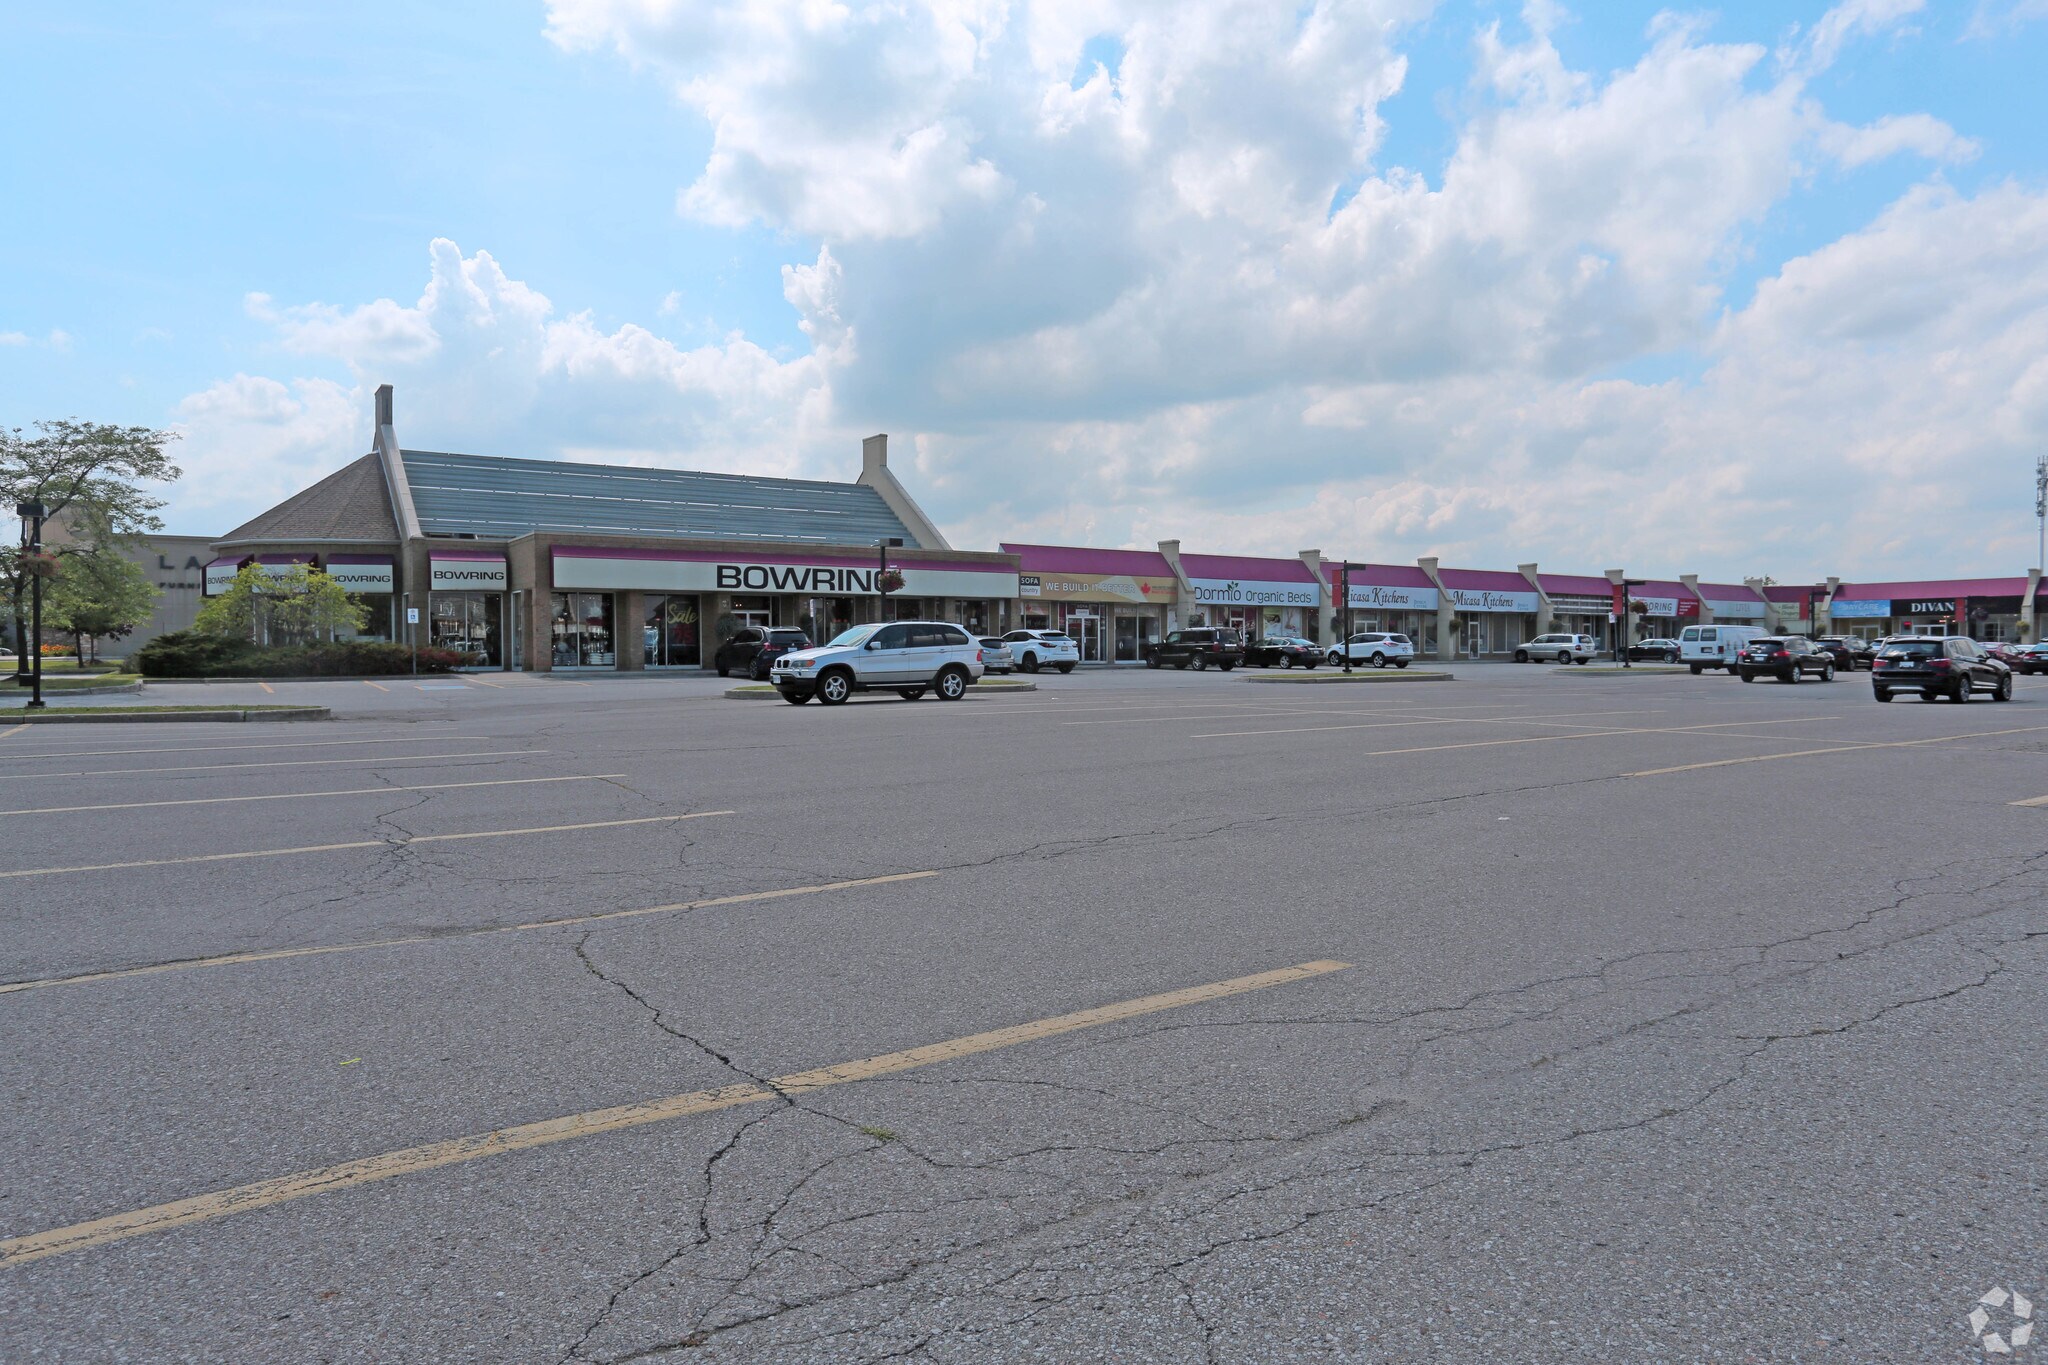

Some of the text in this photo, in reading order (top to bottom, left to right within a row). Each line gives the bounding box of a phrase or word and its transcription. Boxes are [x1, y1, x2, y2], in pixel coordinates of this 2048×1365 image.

[434, 570, 504, 580] BOWRING
[1021, 587, 1038, 595] country
[1045, 582, 1060, 591] WE
[1062, 583, 1089, 592] BUILD
[1245, 590, 1285, 604] Organic
[1287, 591, 1312, 603] Beds
[1371, 587, 1409, 606] Kitchens
[1453, 590, 1480, 606] Micasa
[1482, 592, 1513, 609] Kitchens
[1645, 601, 1672, 612] ORING
[1911, 602, 1955, 612] DIVAN
[668, 603, 698, 624] Sale
